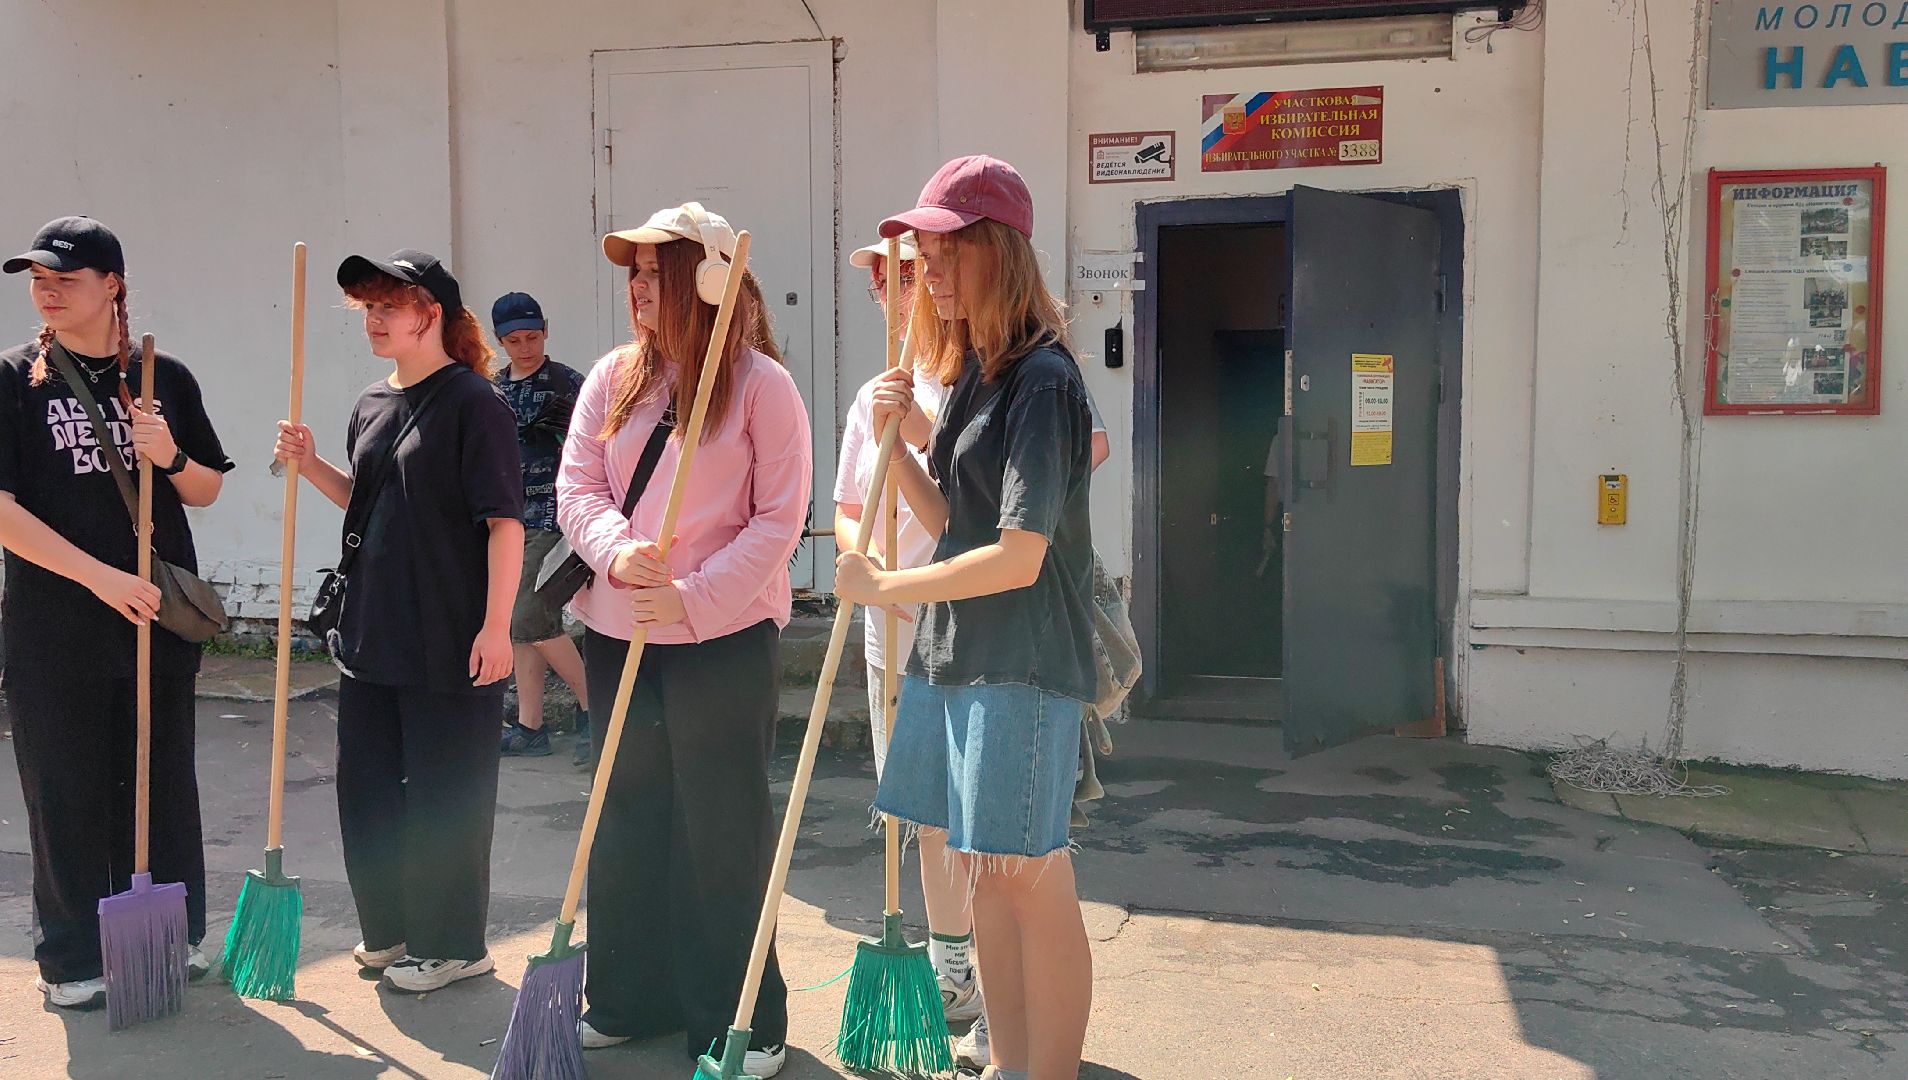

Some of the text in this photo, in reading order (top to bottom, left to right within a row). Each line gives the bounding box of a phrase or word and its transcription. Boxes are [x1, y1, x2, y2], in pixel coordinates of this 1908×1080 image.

[1260, 109, 1378, 125] ИЗБИРАТЕЛЬНАЯ
[1271, 124, 1360, 140] КОМИССИЯ
[1093, 136, 1138, 145] ВНИМАНИЕ!
[1205, 149, 1283, 163] ИЗБИРАТЕЛЬНОГО
[1284, 147, 1326, 159] УЧАСТКА
[1340, 143, 1377, 158] 3388
[1096, 168, 1165, 177] ВИДЕОНАБЛЮДЕНИЕ
[1733, 184, 1859, 201] ИНФОРМАЦИЯ
[53, 239, 75, 251] BEST
[52, 421, 133, 451] NED
